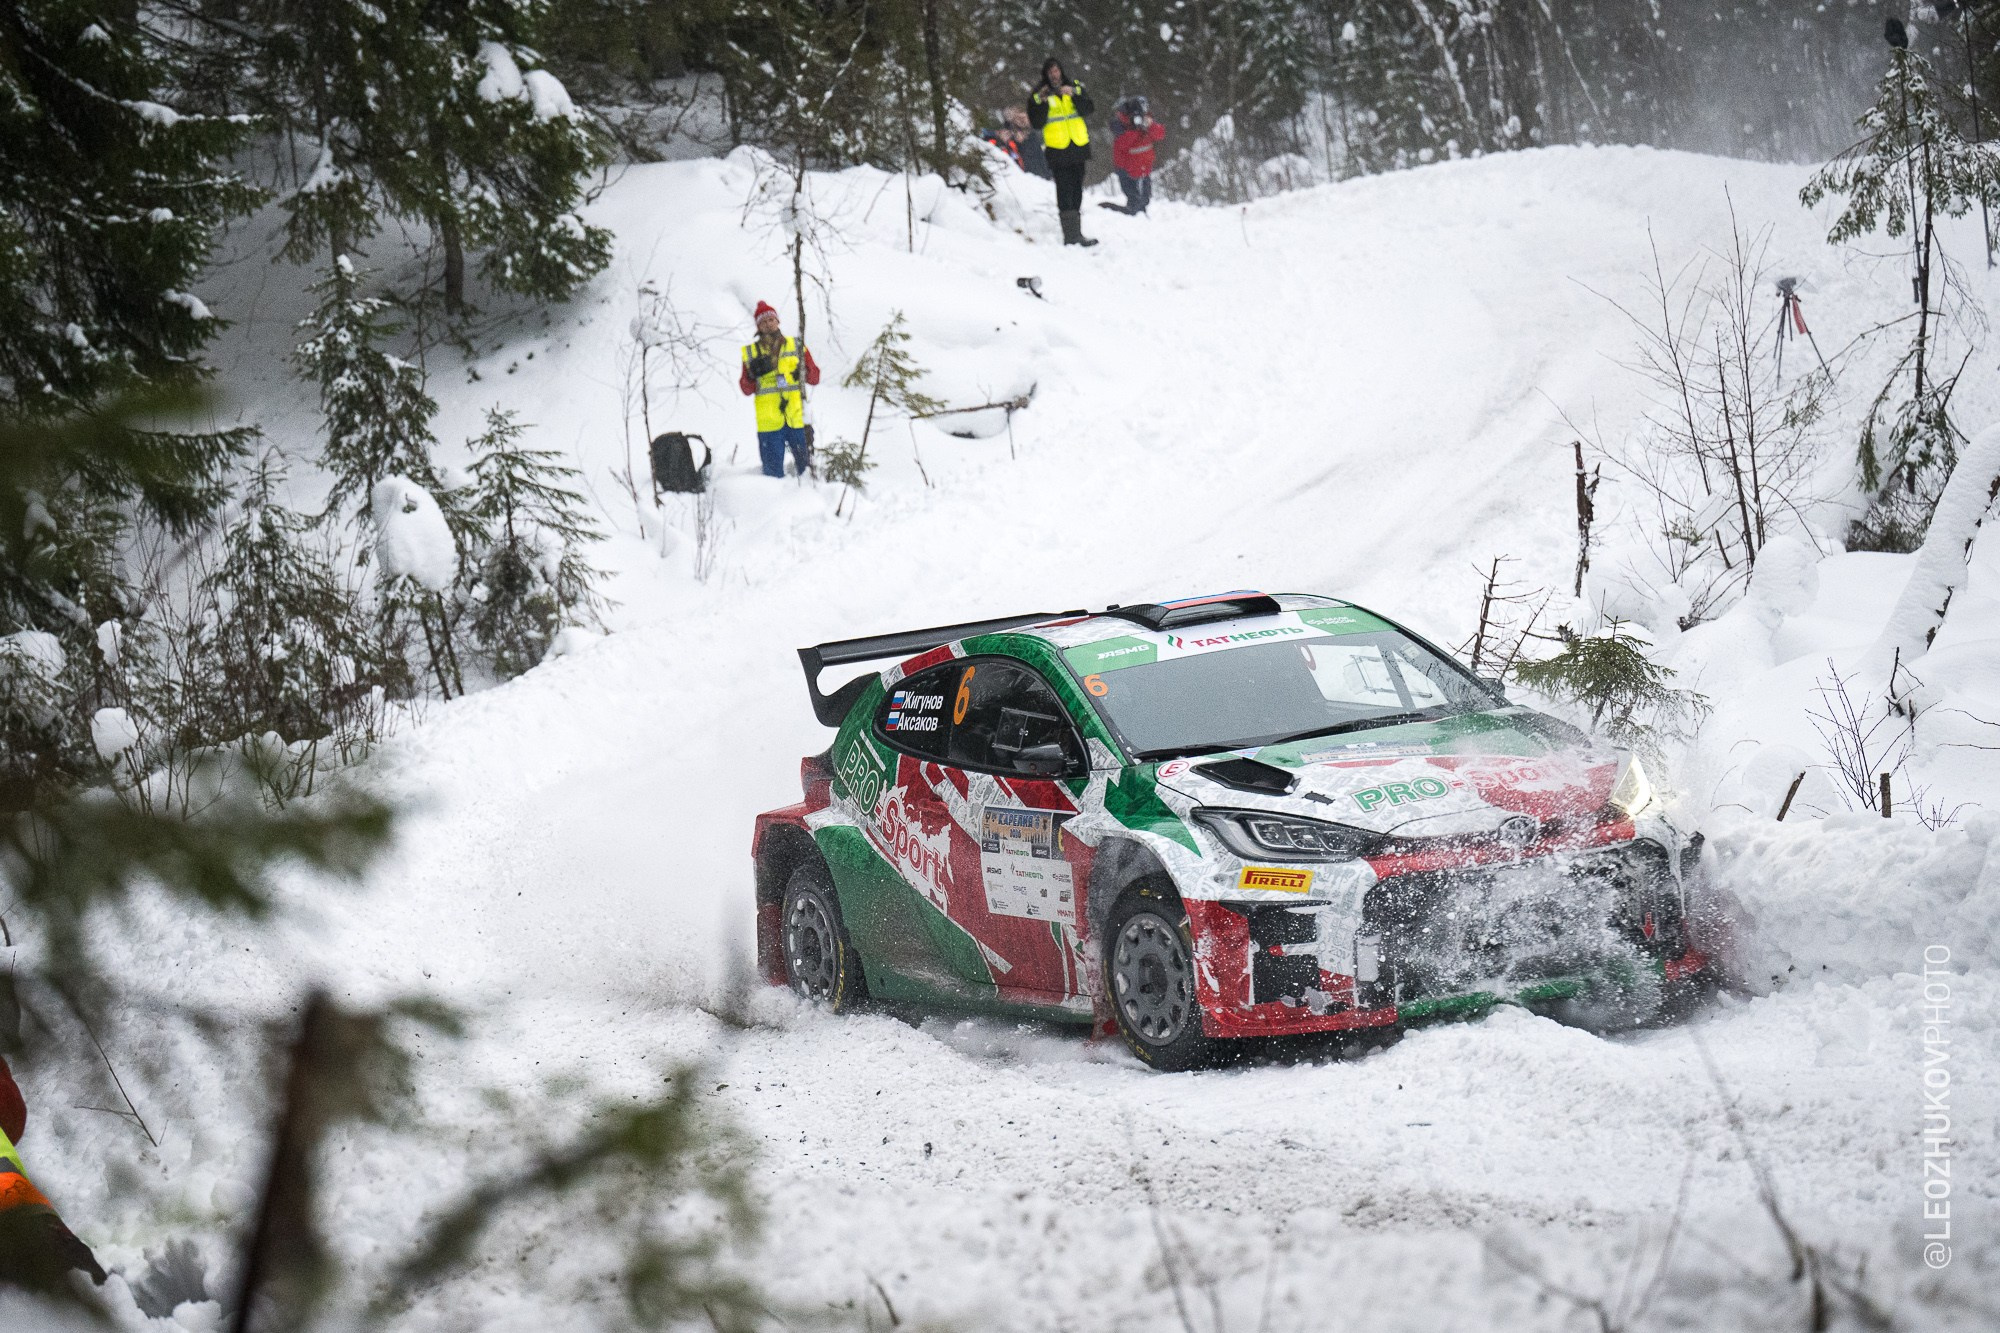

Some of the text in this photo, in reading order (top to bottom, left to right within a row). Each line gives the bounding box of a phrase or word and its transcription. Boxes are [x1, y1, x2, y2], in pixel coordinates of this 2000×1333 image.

[1190, 627, 1304, 648] ТАТНЕФТЬ
[953, 666, 976, 725] 6
[1084, 674, 1109, 697] 6
[901, 691, 944, 714] Жигунов
[896, 712, 939, 731] Аксаков
[998, 812, 1034, 828] КАРЕЛИЯ
[1015, 870, 1044, 879] ТАТНЕФТЬ
[1244, 870, 1307, 888] PIRELLI
